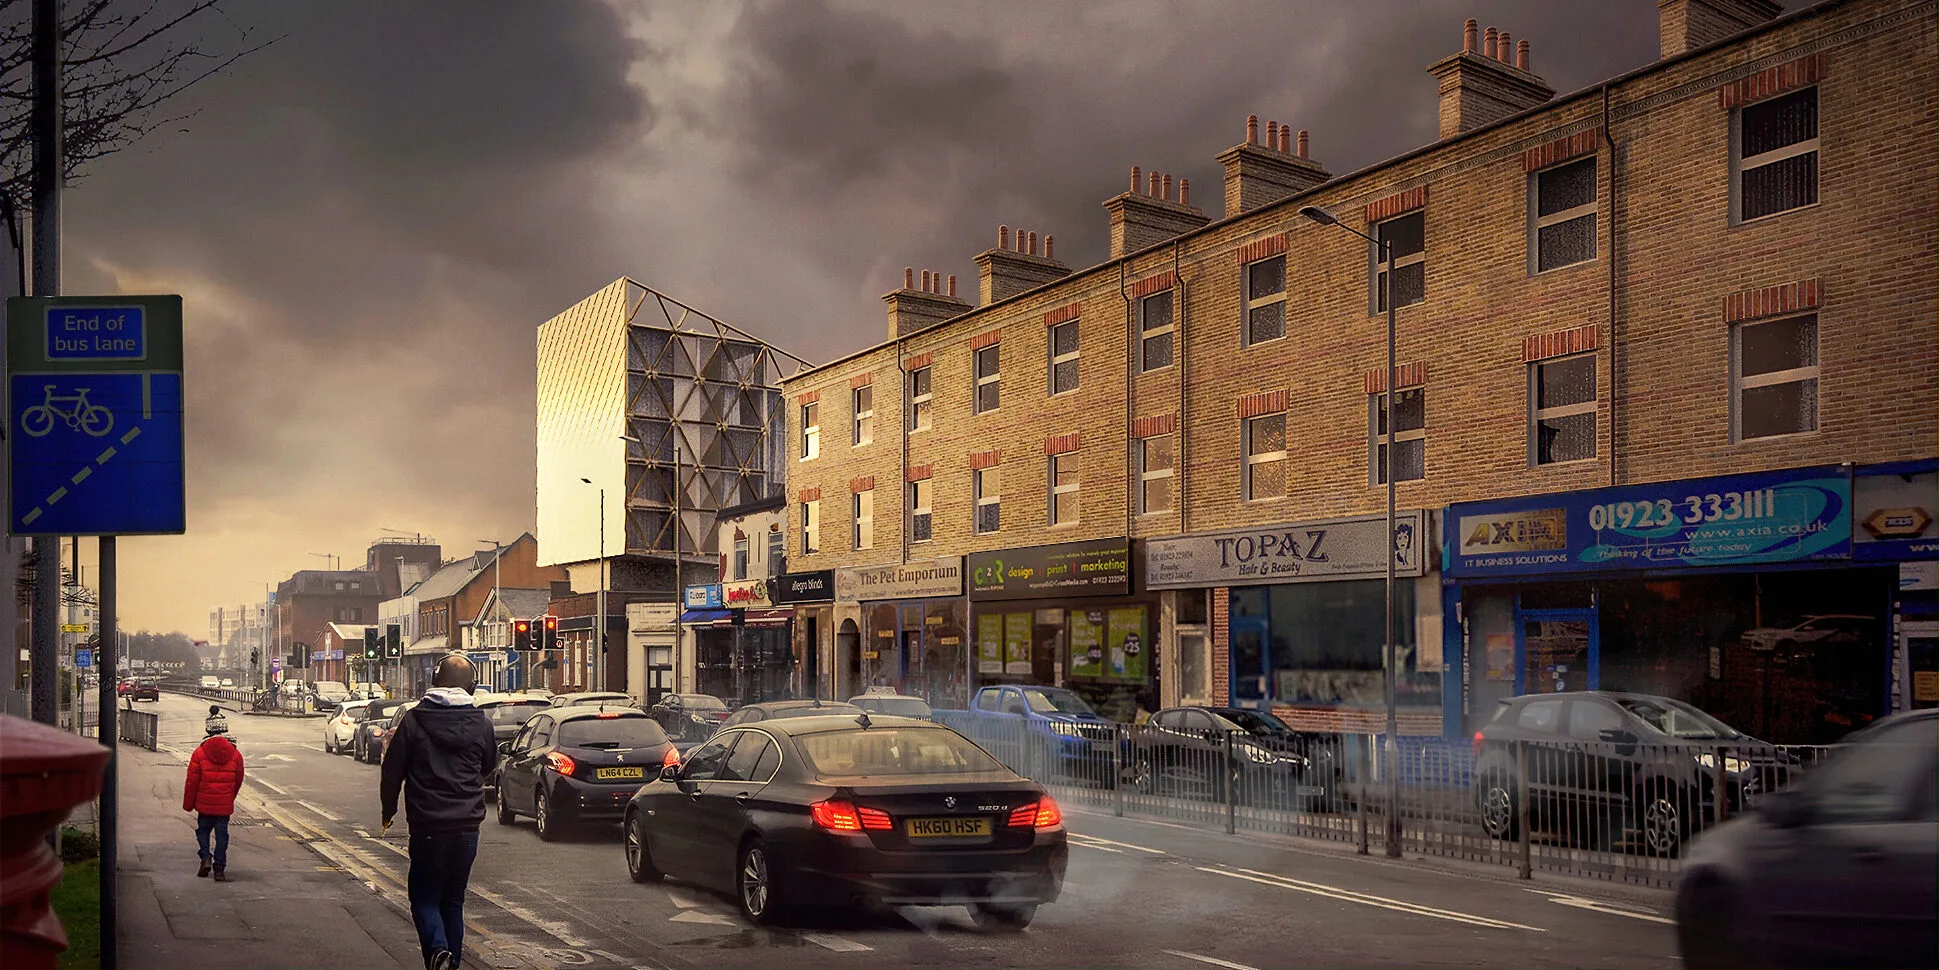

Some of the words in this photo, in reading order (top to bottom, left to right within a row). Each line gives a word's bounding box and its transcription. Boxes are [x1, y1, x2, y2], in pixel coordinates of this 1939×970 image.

[65, 315, 99, 331] End
[106, 314, 125, 331] of
[55, 335, 89, 351] bus
[95, 335, 136, 351] lane
[1589, 498, 1674, 531] 01923
[1684, 488, 1774, 523] 333111
[1465, 520, 1553, 546] AXIA
[1685, 520, 1828, 540] www.axia.co.uk
[1214, 530, 1329, 569] TOPAZ
[1600, 547, 1637, 559] Thinking
[1642, 547, 1652, 558] of
[1657, 547, 1675, 556] the
[1680, 545, 1713, 557] future
[1239, 563, 1258, 576] Hair
[1260, 562, 1269, 575] &
[1271, 561, 1301, 576] Beauty
[1476, 557, 1513, 567] BUSINESS
[1515, 554, 1567, 565] SOLUTIONS
[860, 572, 877, 586] The
[880, 570, 896, 584] Pet
[898, 566, 958, 585] Emporium
[1008, 566, 1034, 580] design
[1047, 562, 1067, 577] print
[1081, 558, 1125, 572] marketing
[791, 580, 808, 594] allegro
[808, 578, 824, 591] blinds
[600, 768, 621, 778] LN64
[623, 768, 638, 777] CZL
[913, 820, 951, 834] HK60
[955, 819, 982, 833] HSF
